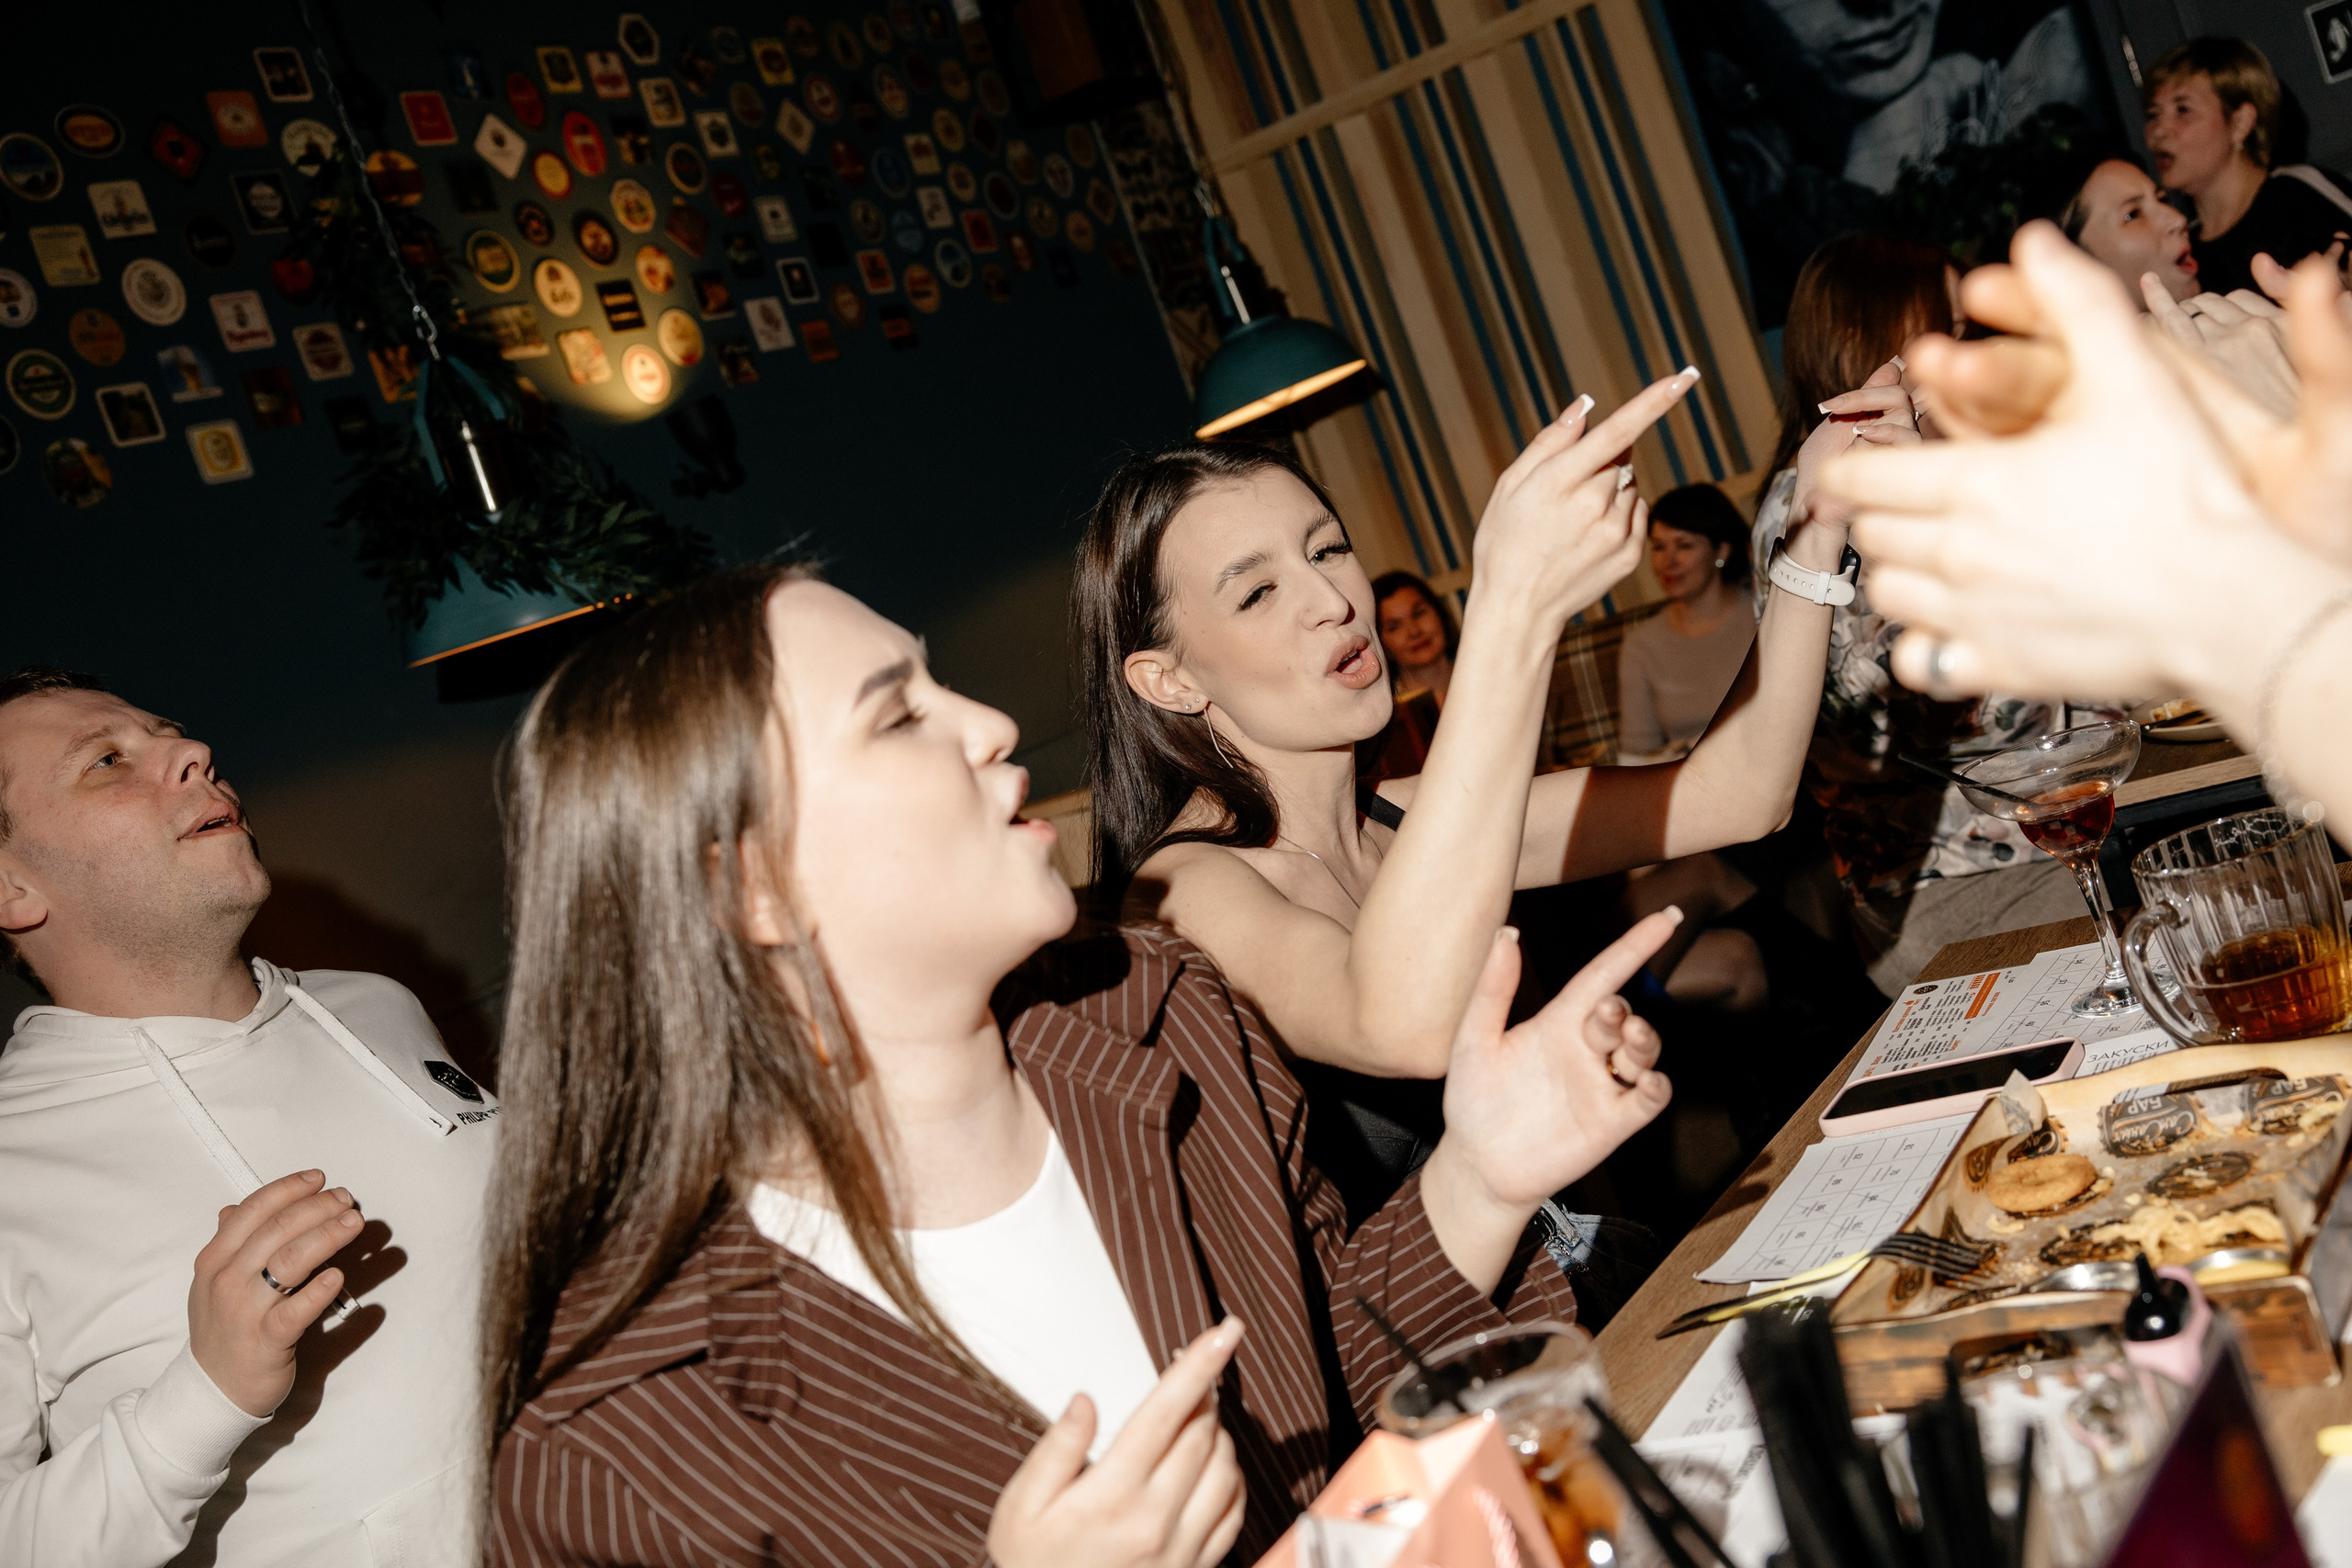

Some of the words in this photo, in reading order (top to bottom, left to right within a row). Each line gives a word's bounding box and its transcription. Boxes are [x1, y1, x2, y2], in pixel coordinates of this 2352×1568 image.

[2086, 1040, 2169, 1063] ЗАКУСКИ
[2270, 1077, 2309, 1096] БАР
[2127, 1096, 2163, 1115] БАР
[456, 1111, 492, 1125] PHILIPP
